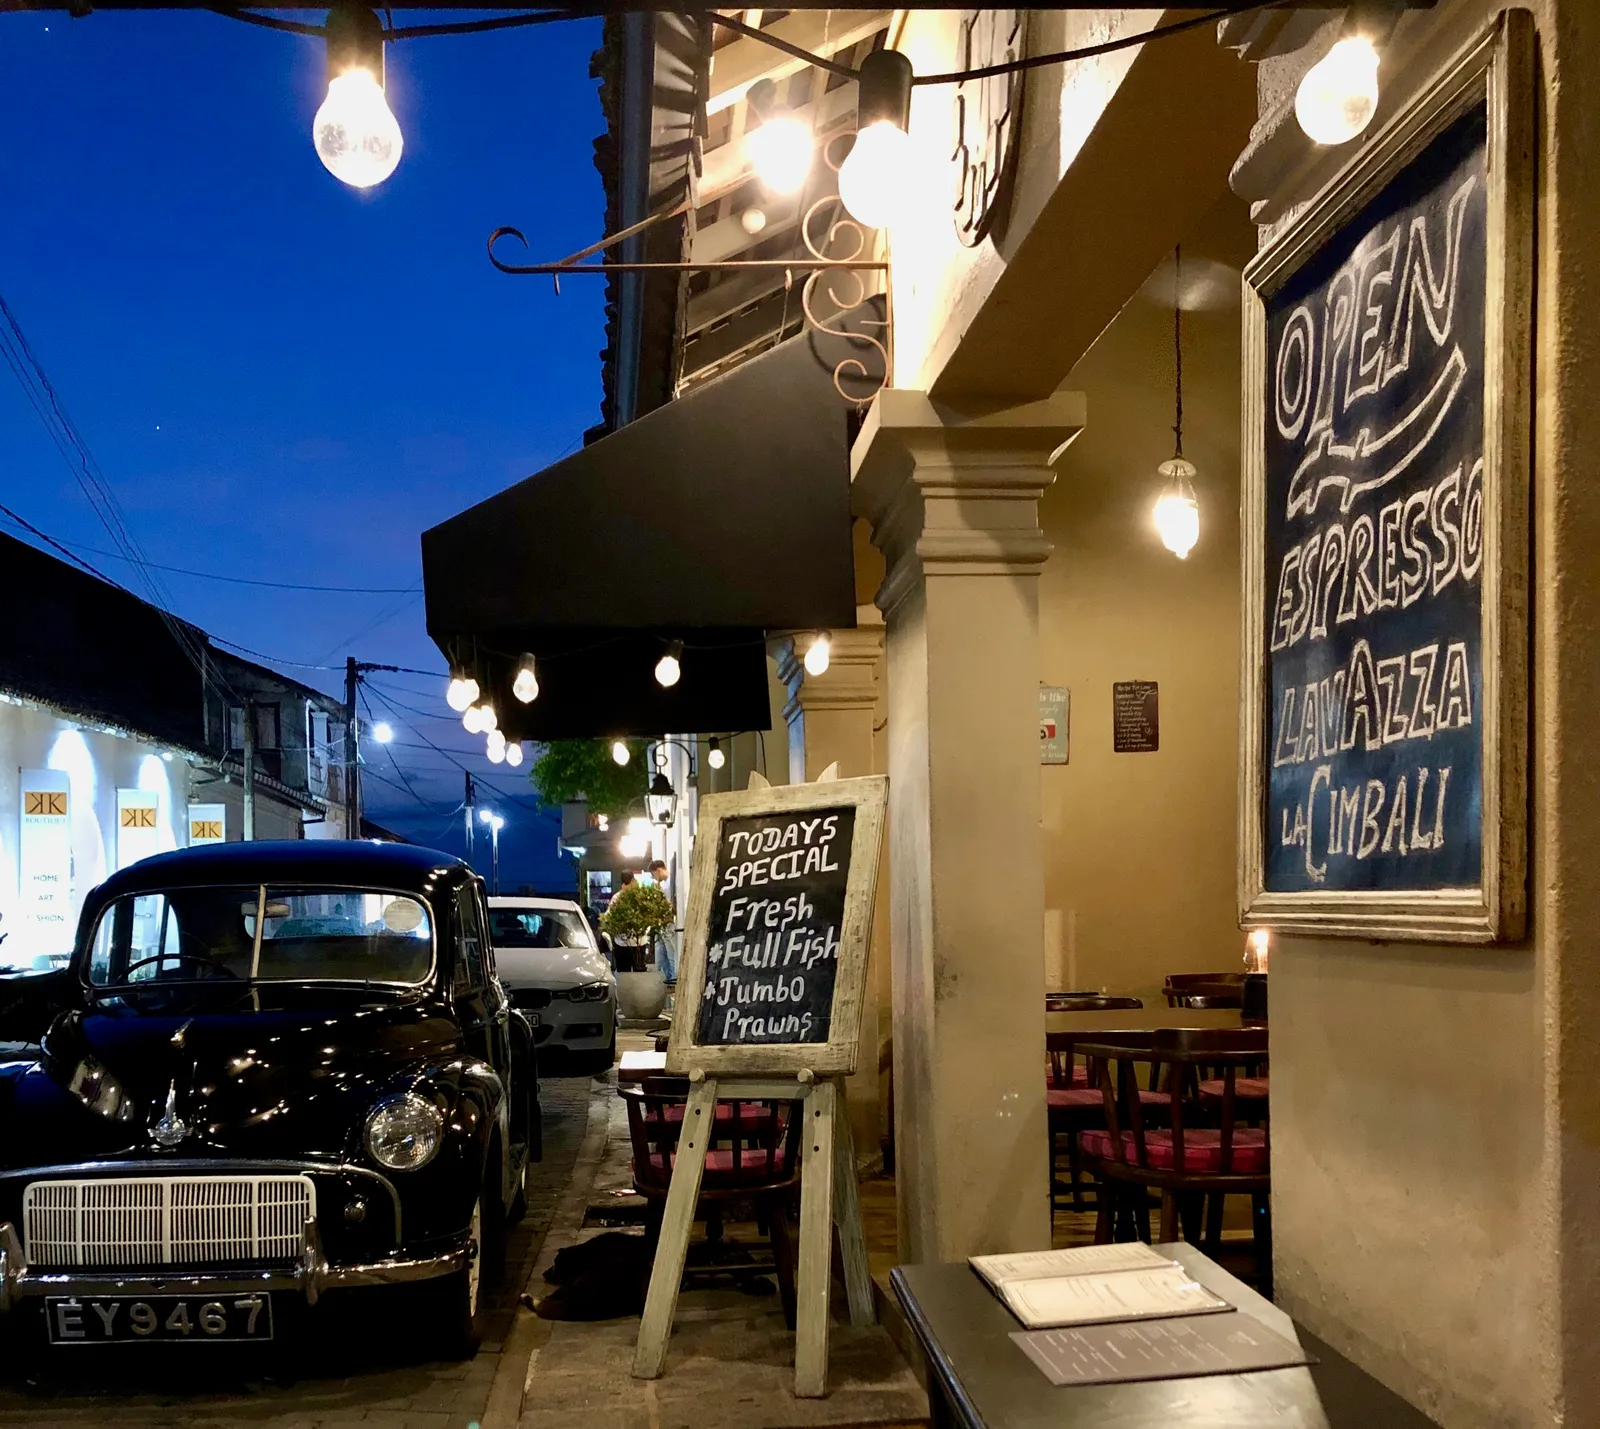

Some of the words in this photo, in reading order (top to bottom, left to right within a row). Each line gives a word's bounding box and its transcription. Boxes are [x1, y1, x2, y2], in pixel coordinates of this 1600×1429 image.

[1275, 174, 1477, 446] OPEN
[1270, 457, 1482, 653] ESPRESSO
[1273, 639, 1471, 768] LAVAZZA
[728, 815, 838, 859] TODAYS
[1281, 803, 1306, 847] LA
[1305, 765, 1452, 883] CIMBALI
[720, 844, 838, 896] SPECIAL
[725, 893, 813, 932] Fresh
[722, 932, 783, 969] Full
[783, 925, 840, 970] Fish
[722, 1007, 812, 1040] Prawns
[57, 1299, 263, 1337] EY9467
